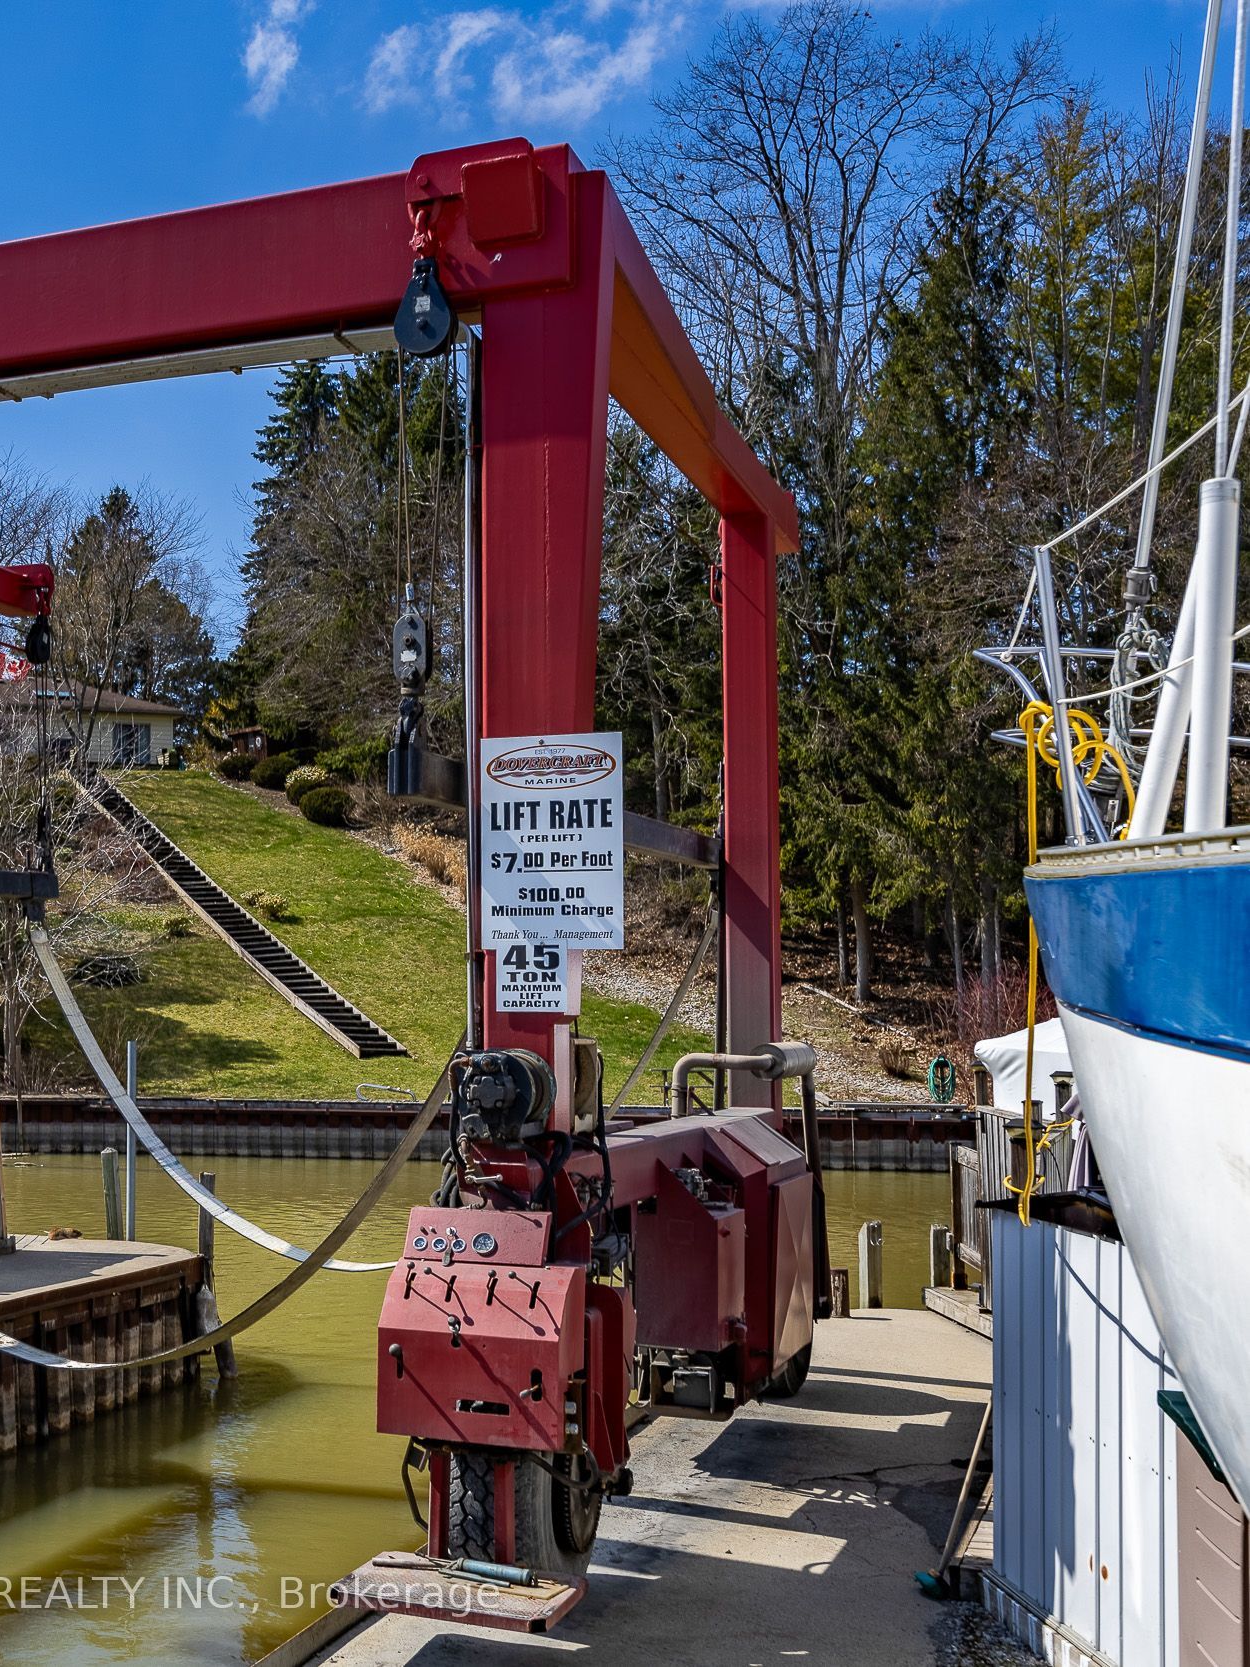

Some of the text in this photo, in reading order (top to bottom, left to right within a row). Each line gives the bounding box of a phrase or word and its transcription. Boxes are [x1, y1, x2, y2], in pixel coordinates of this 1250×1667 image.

[493, 754, 605, 772] DOVERCRAFT
[525, 777, 576, 785] MARINE
[490, 798, 612, 831] LIFT RATE
[491, 851, 613, 874] $7.00 Per Foot
[519, 887, 584, 902] $100.00
[492, 905, 614, 917] Minimum Charge
[492, 930, 521, 939] Thank
[554, 929, 613, 941] Management
[503, 945, 560, 971] 45
[507, 972, 557, 982] TON
[502, 984, 562, 992] MAXIMUM
[503, 1000, 560, 1008] CAPACITY
